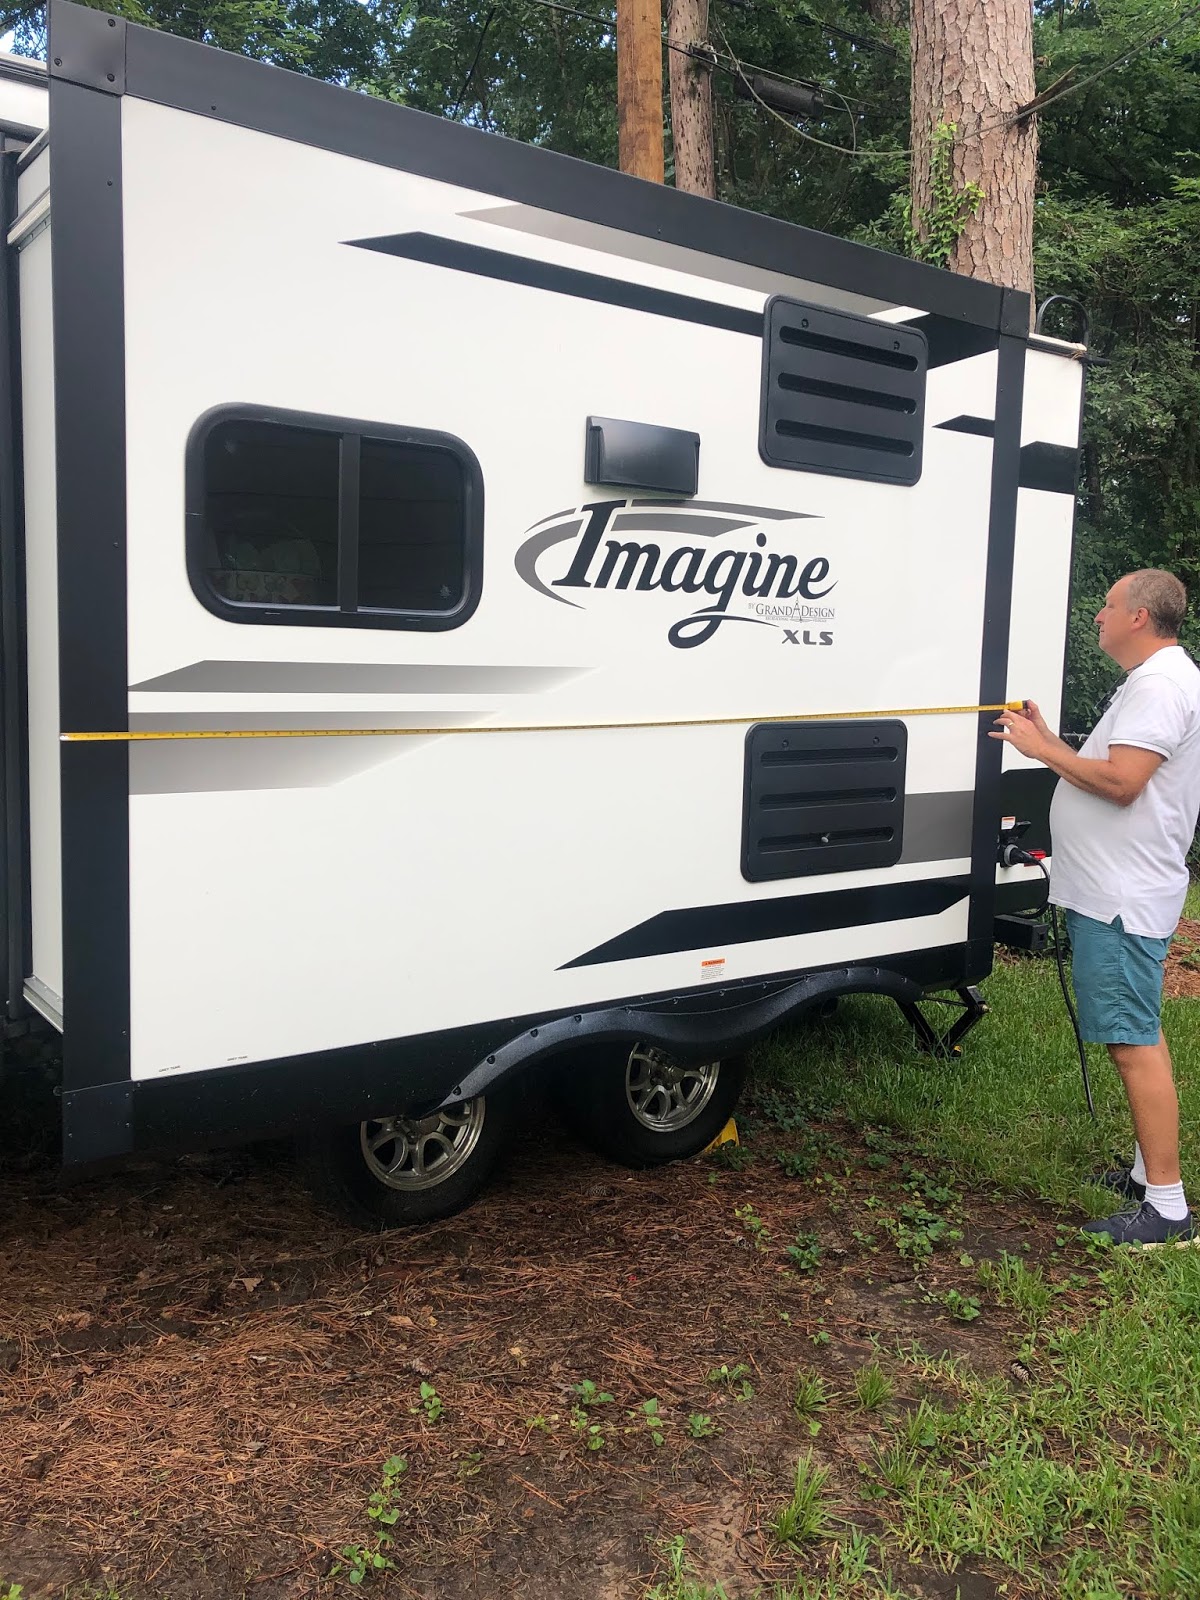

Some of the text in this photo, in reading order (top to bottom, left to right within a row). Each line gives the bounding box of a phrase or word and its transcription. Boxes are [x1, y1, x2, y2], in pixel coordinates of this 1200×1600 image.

[551, 499, 839, 649] Imagine
[755, 603, 793, 616] GRAND
[801, 605, 836, 618] DESIGN
[781, 629, 834, 646] XLS
